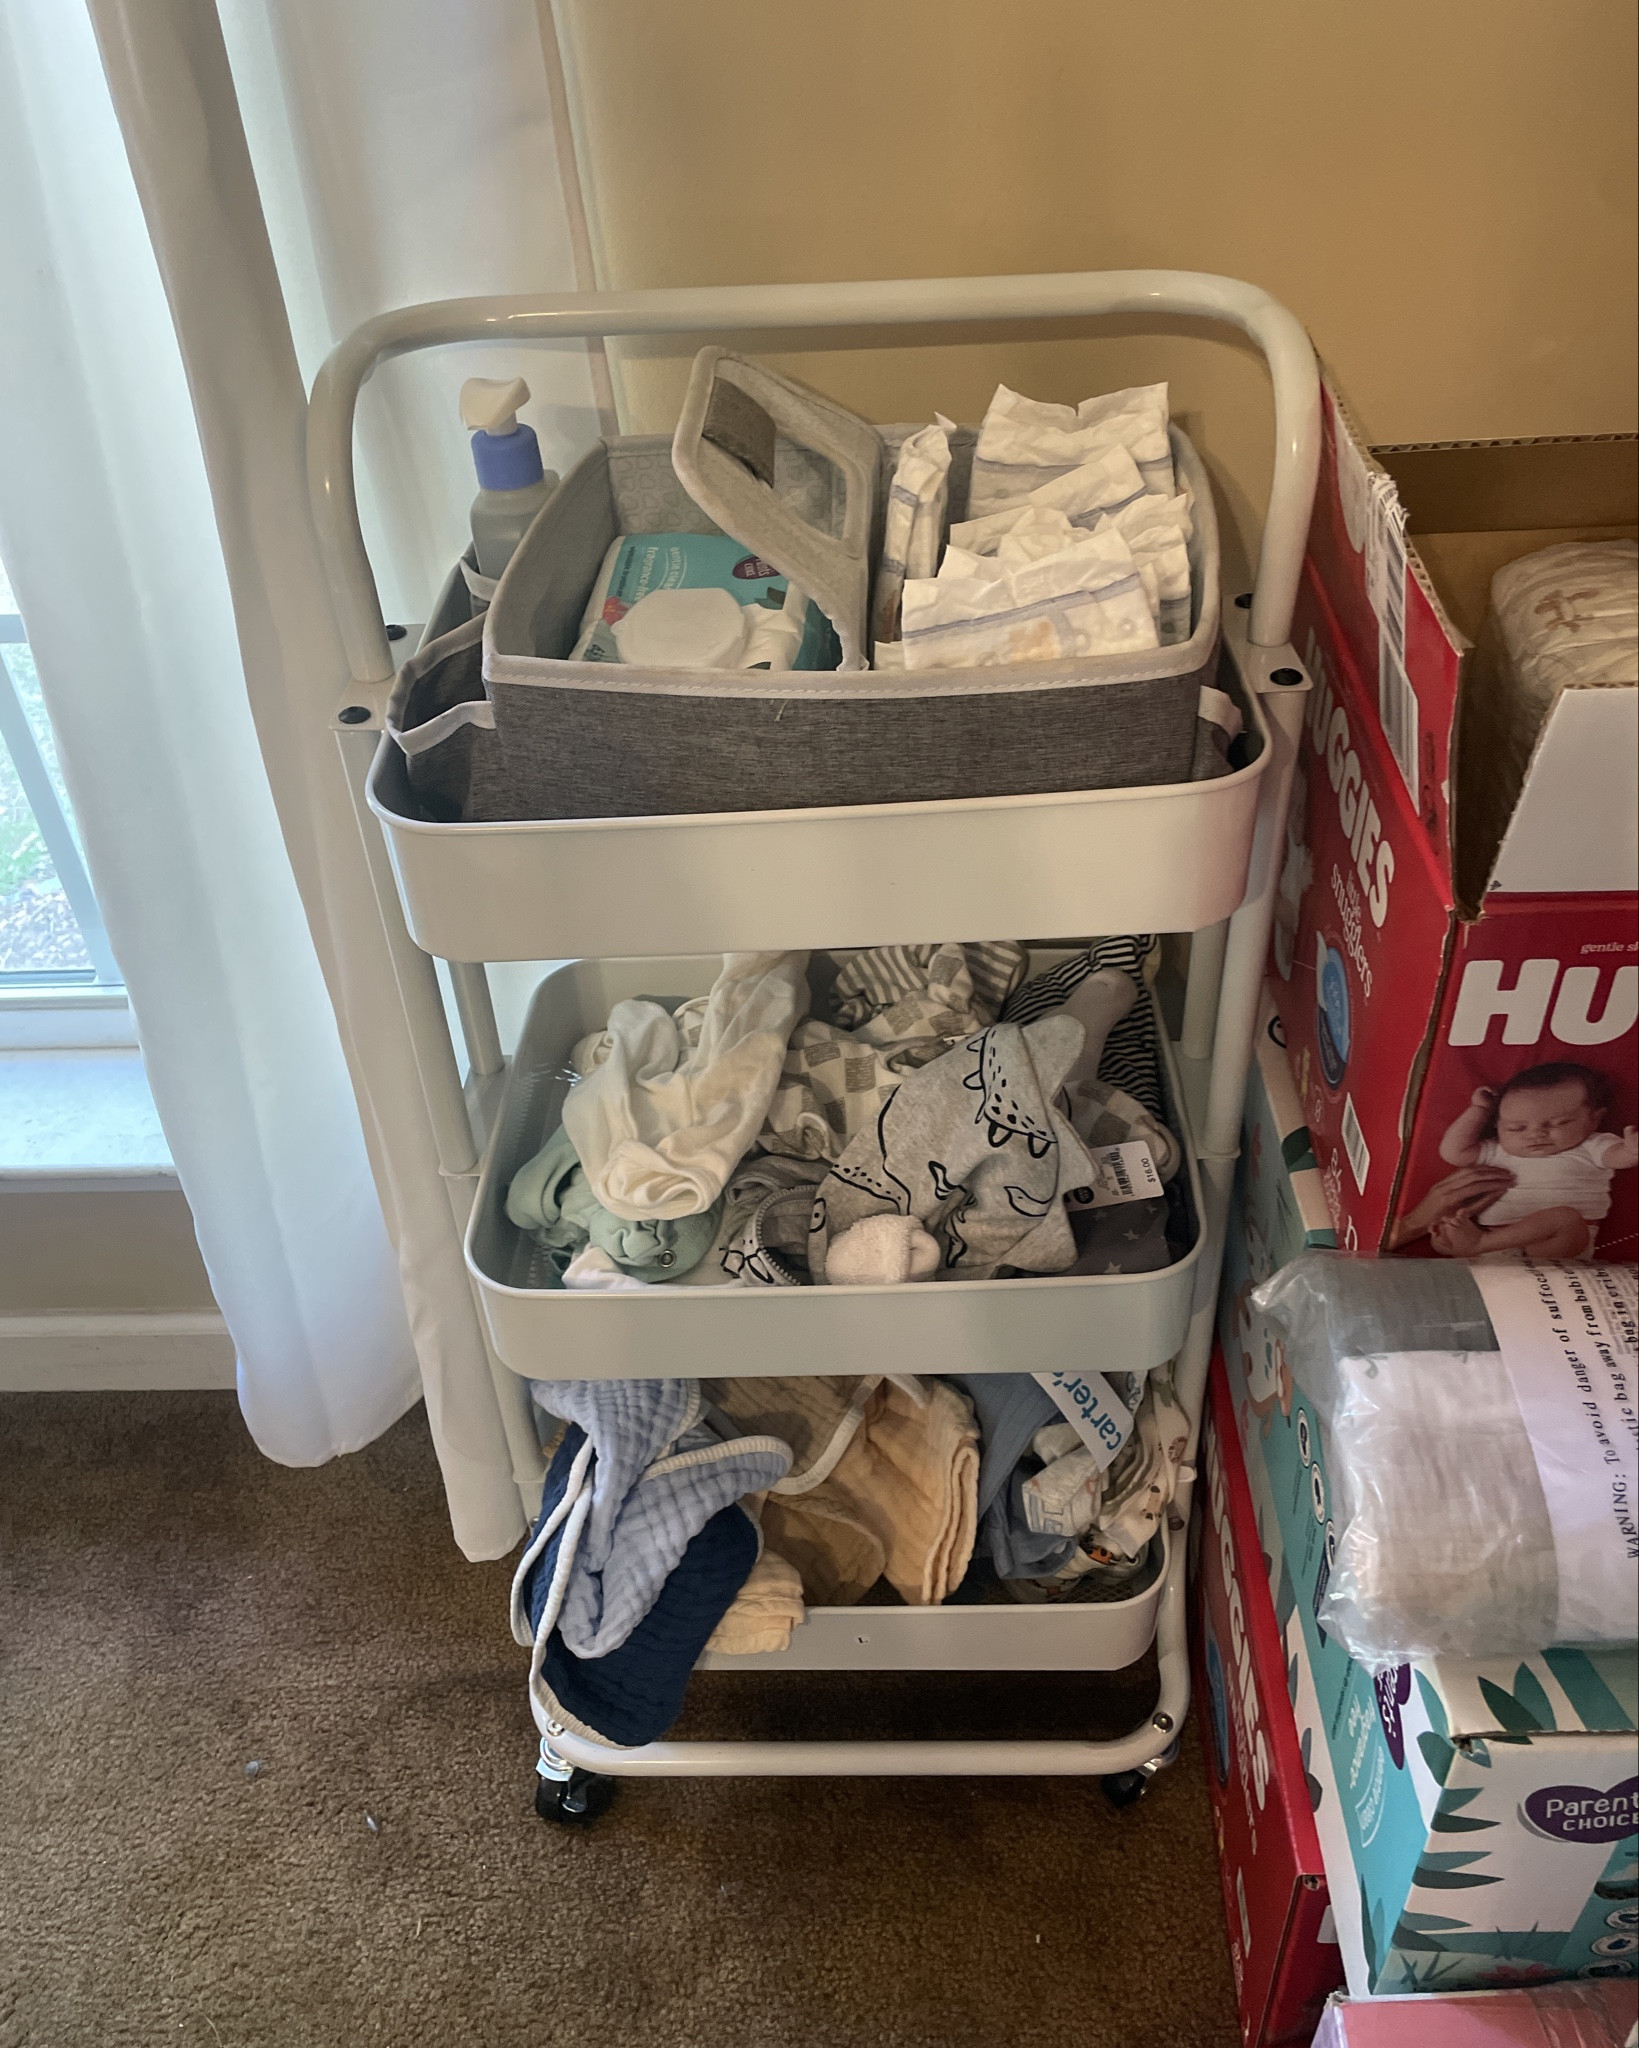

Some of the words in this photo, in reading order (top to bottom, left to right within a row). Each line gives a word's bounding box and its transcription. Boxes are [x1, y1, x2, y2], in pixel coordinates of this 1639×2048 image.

[1580, 942, 1624, 954] gentle
[1612, 1301, 1625, 1315] in
[1582, 1305, 1602, 1336] from
[1621, 1321, 1638, 1343] bag
[1552, 1327, 1570, 1343] of
[1594, 1341, 1617, 1368] away
[1564, 1350, 1592, 1393] danger
[1611, 1373, 1628, 1401] bag
[1582, 1402, 1610, 1445] avoid
[1603, 1449, 1620, 1465] To
